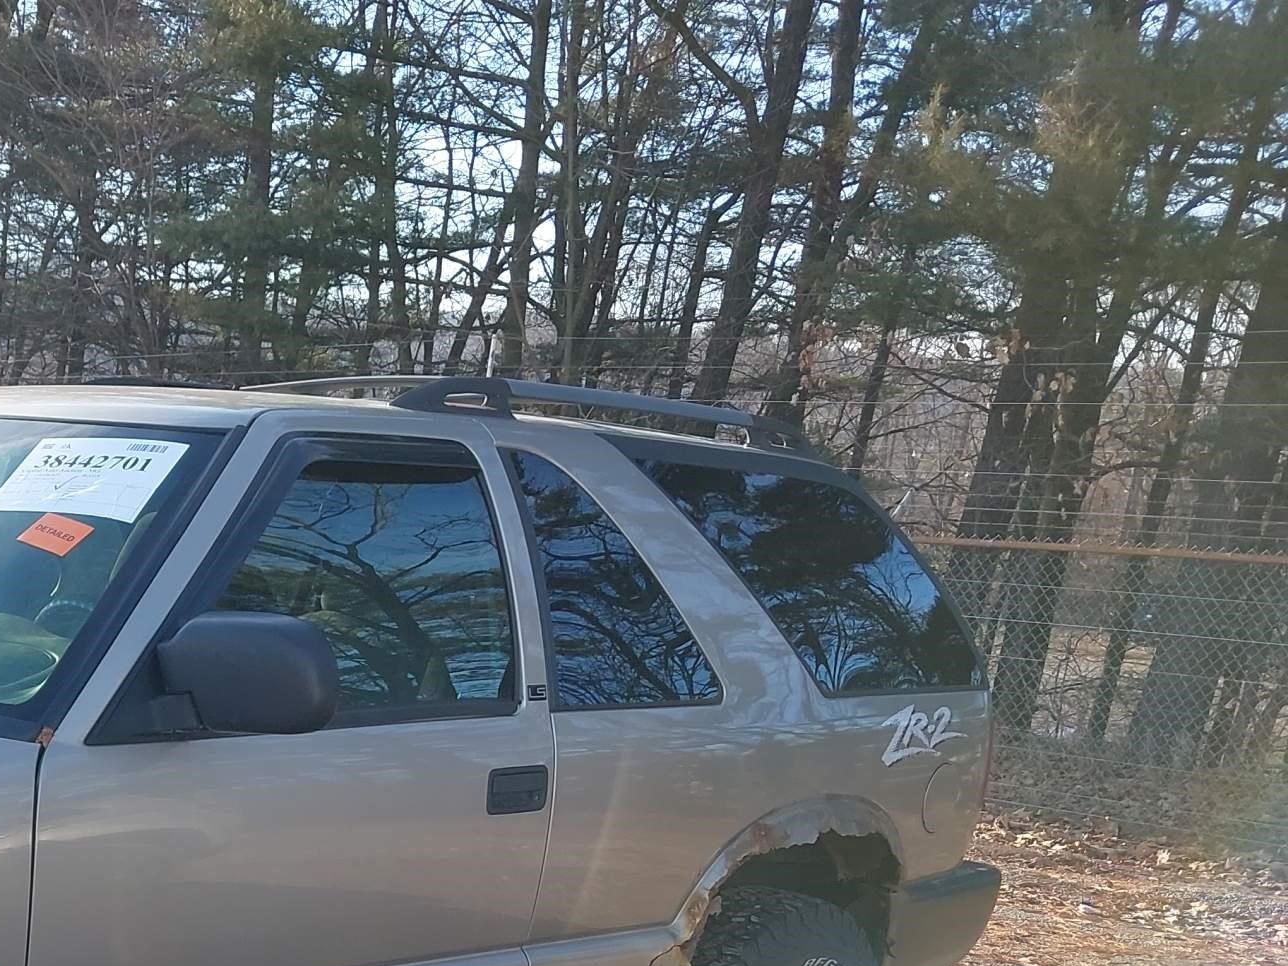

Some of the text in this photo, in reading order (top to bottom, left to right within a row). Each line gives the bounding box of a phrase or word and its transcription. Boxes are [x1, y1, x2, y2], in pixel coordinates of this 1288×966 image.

[33, 454, 153, 472] 38442701
[34, 523, 77, 543] DETAILED
[528, 686, 547, 699] LS
